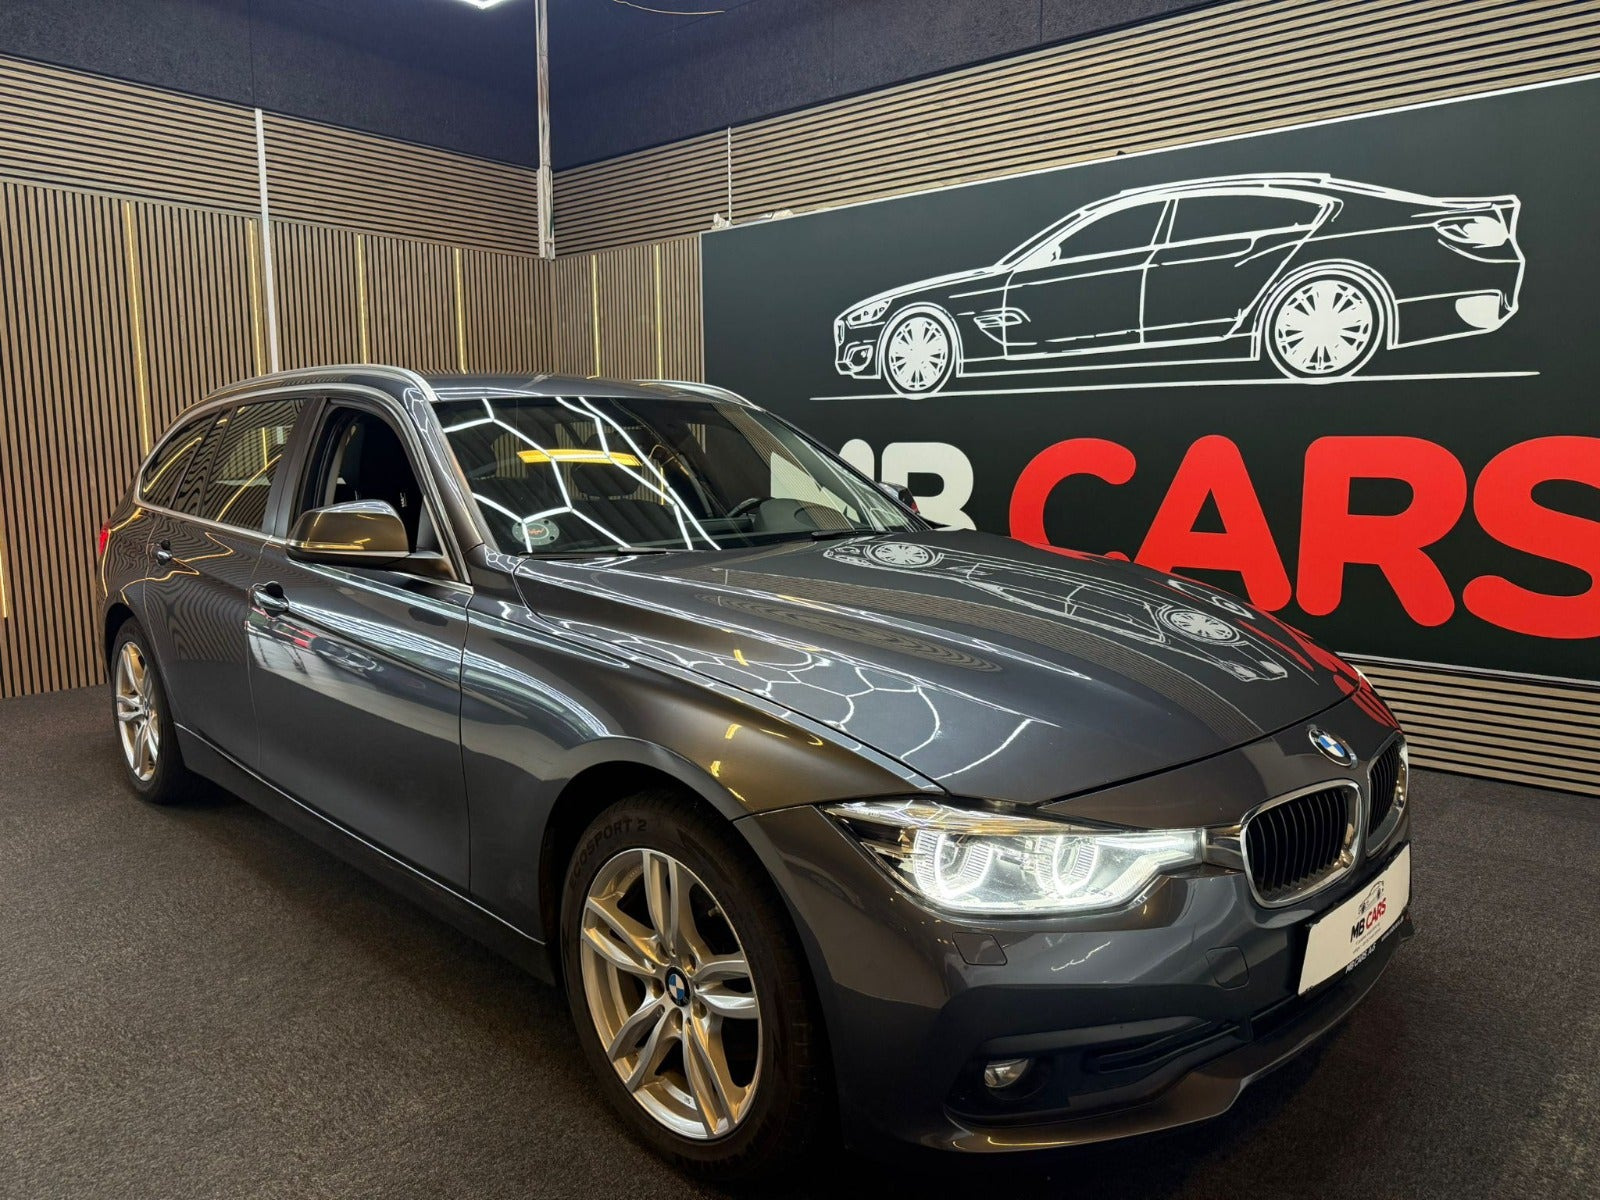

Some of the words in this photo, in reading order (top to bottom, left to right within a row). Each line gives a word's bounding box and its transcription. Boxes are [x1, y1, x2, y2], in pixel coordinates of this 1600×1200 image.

[1008, 434, 1600, 640] CARS
[637, 819, 647, 832] 2
[1350, 918, 1366, 943] MB
[1366, 897, 1387, 929] CARS
